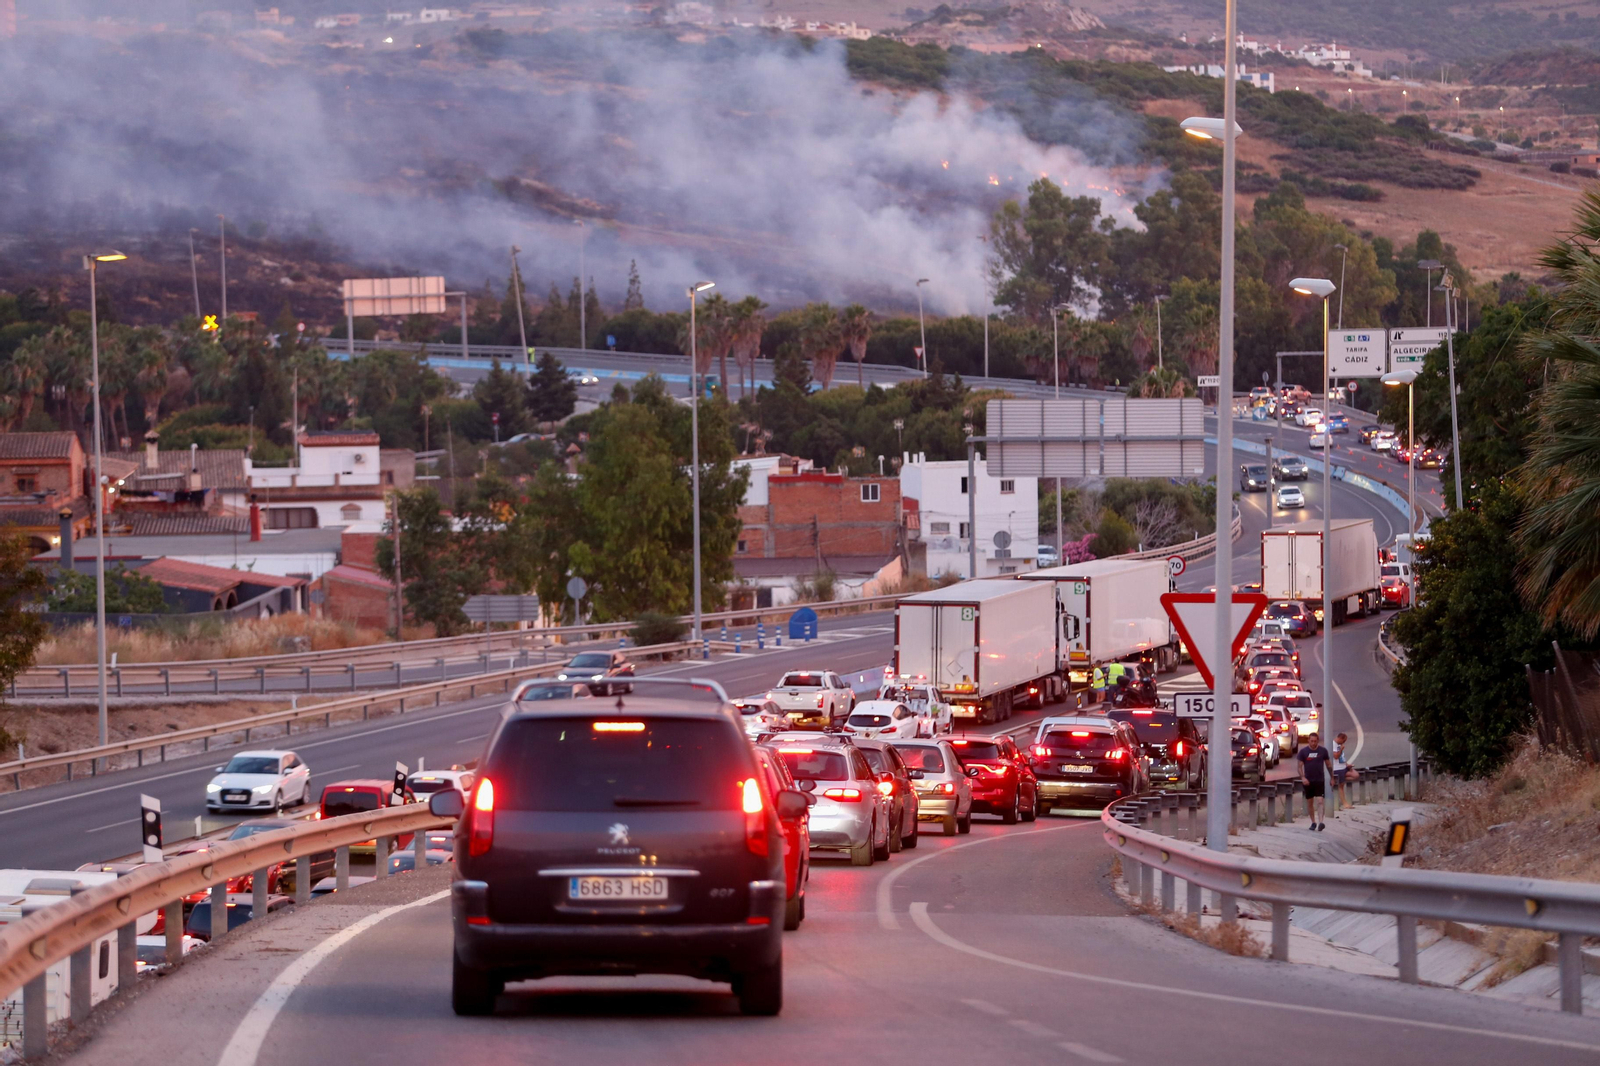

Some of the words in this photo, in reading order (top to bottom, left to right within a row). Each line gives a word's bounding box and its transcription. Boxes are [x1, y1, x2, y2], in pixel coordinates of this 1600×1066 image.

[1075, 582, 1085, 594] 9
[962, 608, 973, 620] 8
[580, 880, 623, 895] 6863
[631, 881, 663, 895] HSD
